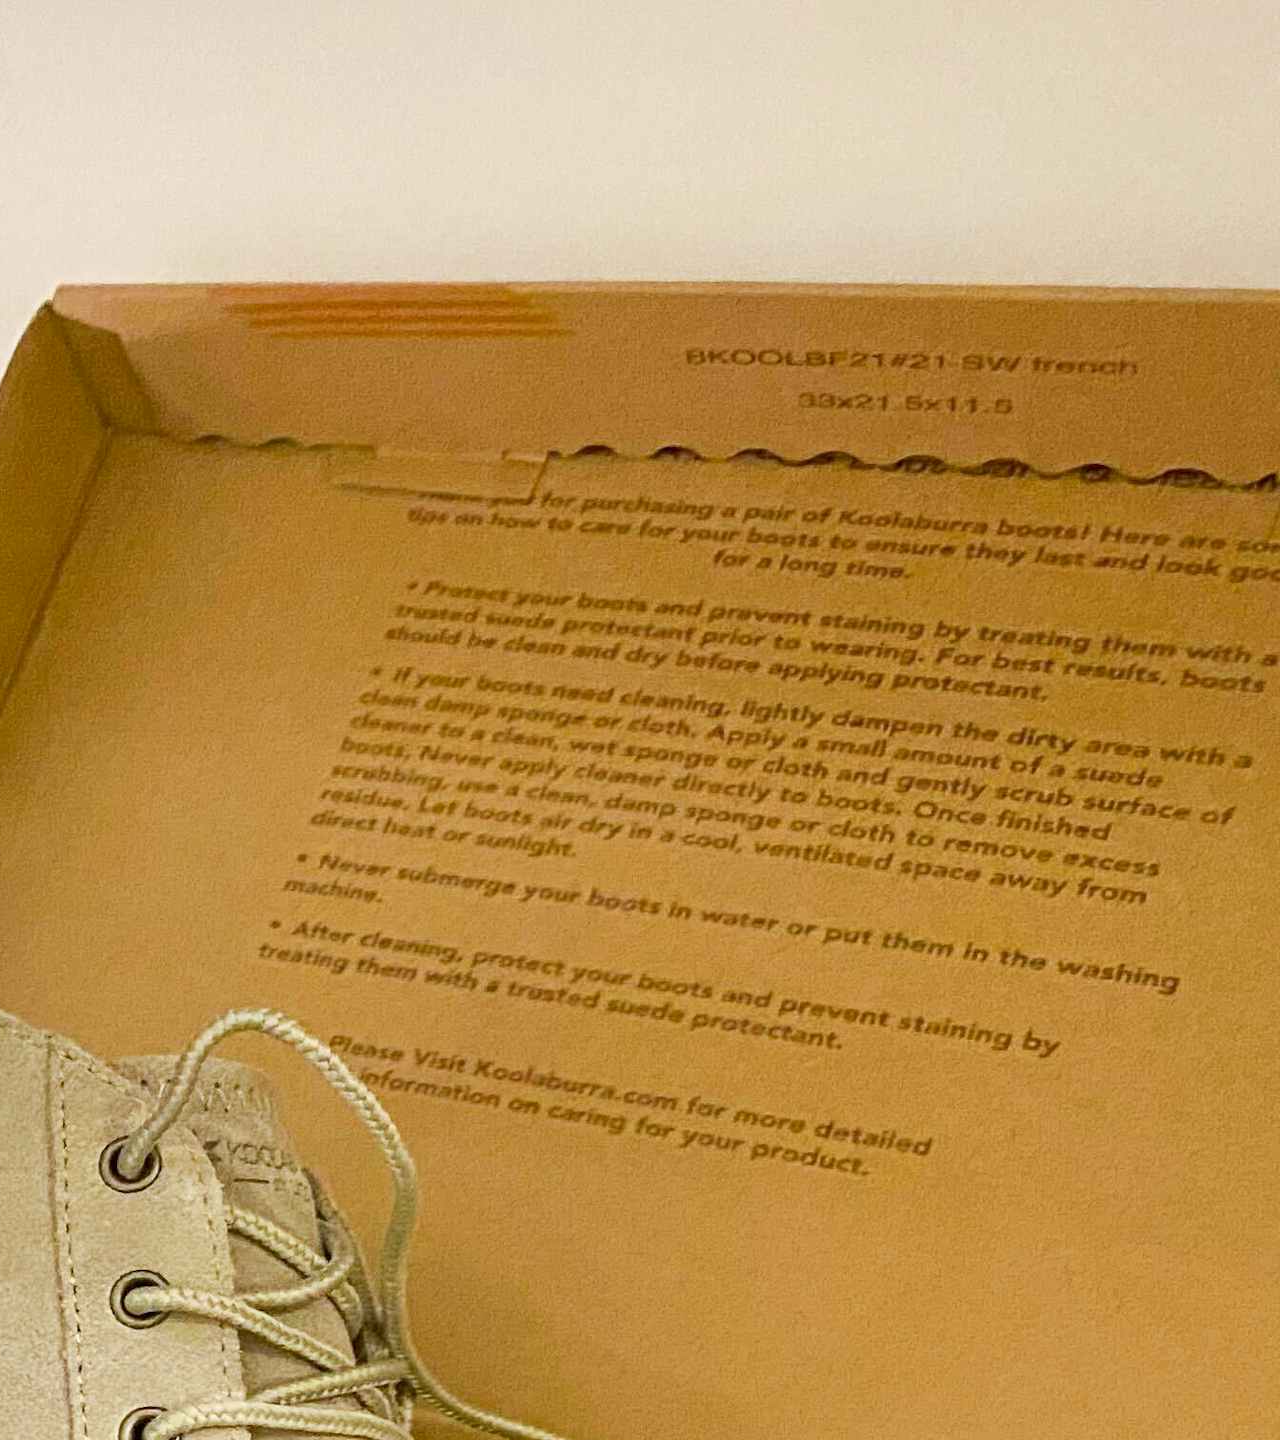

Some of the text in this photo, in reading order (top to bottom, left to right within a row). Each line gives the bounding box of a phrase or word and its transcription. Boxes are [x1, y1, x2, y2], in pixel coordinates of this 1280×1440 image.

[579, 496, 717, 521] purchasing
[719, 505, 738, 519] a
[741, 505, 796, 523] pair
[800, 506, 833, 524] of
[838, 509, 988, 535] Koolaburra
[1099, 524, 1171, 547] Here
[1178, 534, 1227, 550] are
[637, 518, 677, 538] for
[678, 527, 741, 544] your
[745, 526, 820, 549] boots
[828, 533, 859, 551] to
[864, 539, 957, 557] ensure
[964, 541, 1027, 567] they
[1033, 545, 1087, 567] last
[1090, 552, 1150, 572] and
[1155, 554, 1221, 576] look
[712, 548, 751, 568] for
[755, 555, 773, 570] a
[779, 553, 838, 579] long
[560, 619, 697, 642] protectant
[698, 627, 767, 649] prior
[772, 634, 801, 651] to
[933, 646, 985, 667] For
[990, 649, 1056, 674] best
[1179, 668, 1266, 693] boots
[576, 592, 1280, 667] boots and prevent staining by treating them with a
[624, 645, 669, 669] dry
[675, 649, 761, 674] before
[768, 661, 884, 690] applying
[705, 723, 787, 751] Apply
[791, 735, 809, 750] a
[816, 738, 888, 758] small
[892, 747, 1001, 770] amount
[1008, 754, 1045, 775] of
[1046, 763, 1066, 778] a
[1072, 766, 1163, 788] suede
[740, 699, 825, 729] lightly
[831, 709, 943, 738] dampen
[951, 721, 999, 742] the
[1006, 726, 1077, 756] dirty
[1083, 739, 1150, 759] area
[1159, 745, 1226, 766] with
[1232, 754, 1253, 769] a
[568, 739, 1236, 826] wet sponge or cloth and gently scrub surface of
[573, 762, 666, 787] cleaner
[671, 773, 771, 804] directly
[778, 786, 809, 805] to
[912, 799, 987, 826] Once
[996, 808, 1112, 841] finished
[539, 812, 573, 830] air
[576, 815, 624, 840] dry
[627, 821, 653, 839] in
[658, 829, 676, 843] a
[754, 842, 894, 871] ventilated
[898, 859, 982, 882] space
[988, 871, 1068, 898] away
[1076, 876, 1147, 904] from
[603, 792, 1160, 877] damp sponge or cloth to remove excess
[519, 885, 581, 903] your
[586, 887, 661, 915] boots
[667, 900, 692, 920] in
[700, 910, 779, 930] water
[786, 921, 818, 936] or
[821, 926, 873, 945] put
[881, 931, 954, 957] them
[962, 941, 989, 963] in
[999, 947, 1047, 971] the
[1057, 960, 1180, 996] washing
[506, 981, 601, 1009] trusted
[605, 999, 685, 1023] suede
[569, 967, 632, 985] your
[635, 973, 713, 999] boots
[721, 989, 774, 1008] and
[777, 998, 890, 1027] prevent
[897, 1015, 1012, 1051] staining
[1021, 1027, 1061, 1059] by
[507, 1097, 541, 1115] on
[547, 1105, 627, 1135] caring
[634, 1115, 676, 1138] for
[678, 1129, 745, 1151] your
[685, 1095, 727, 1119] for
[732, 1109, 806, 1134] more
[814, 1120, 933, 1156] detailed
